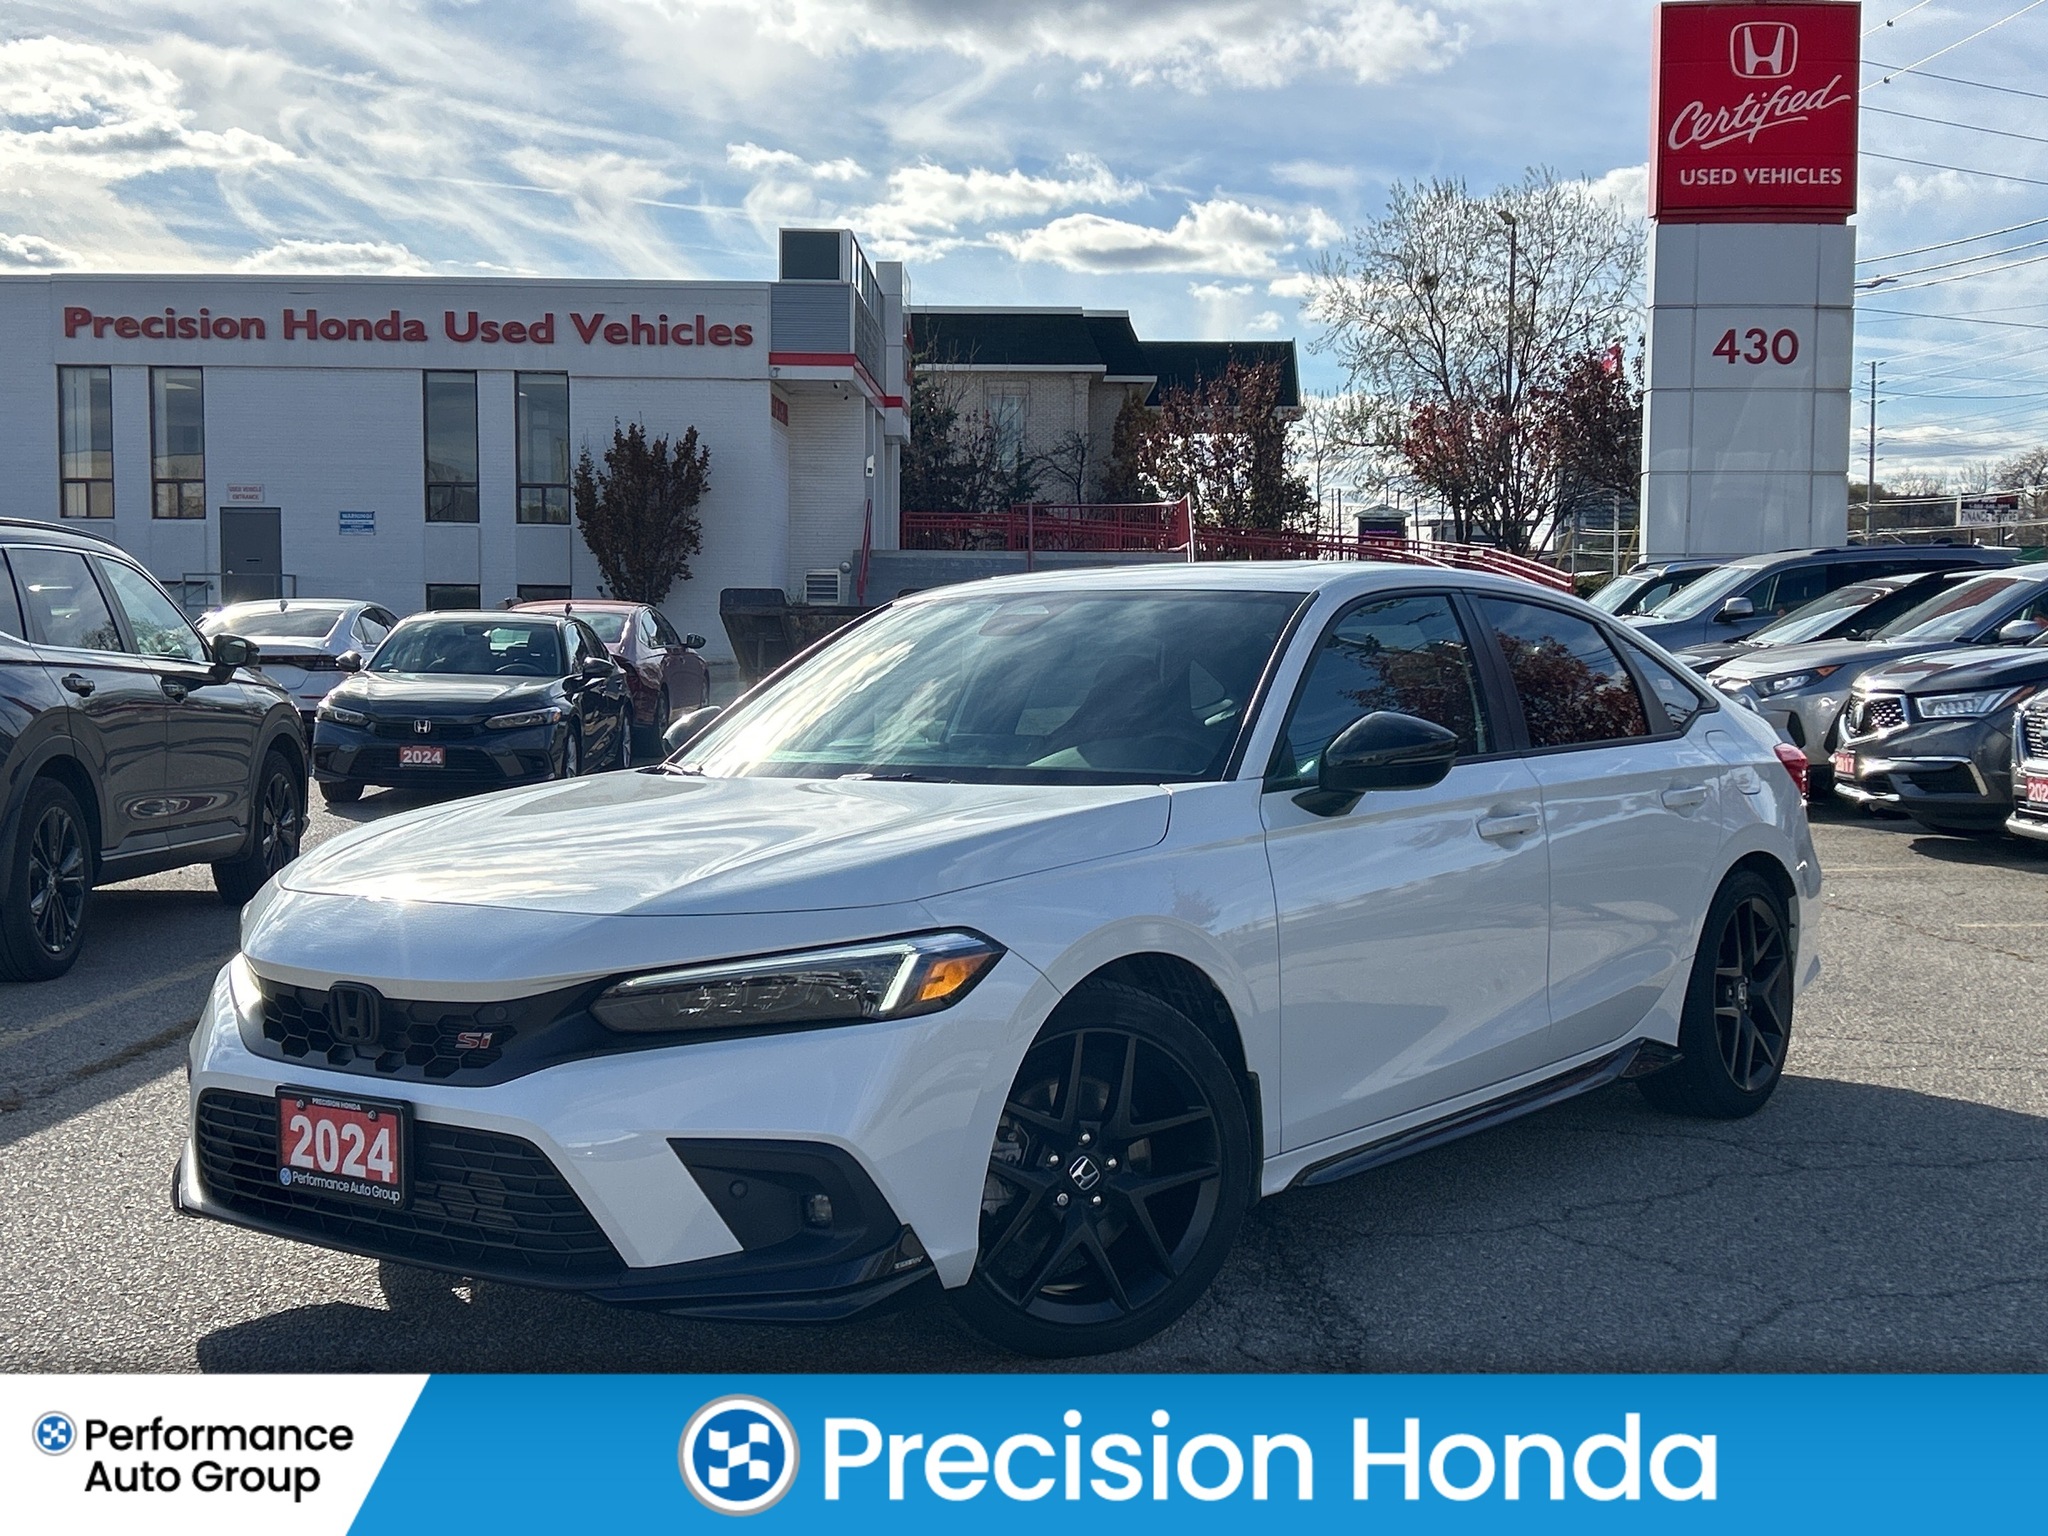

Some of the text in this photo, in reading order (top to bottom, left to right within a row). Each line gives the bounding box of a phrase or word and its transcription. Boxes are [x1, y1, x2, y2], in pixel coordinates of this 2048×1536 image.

[1668, 74, 1852, 150] Certified
[1680, 167, 1842, 186] USED VEHICLES
[64, 307, 754, 348] Precision Honda Used Vehicles
[1712, 328, 1800, 365] 430
[403, 750, 442, 764] 2024
[2028, 782, 2048, 802] 202
[312, 1097, 361, 1111] PRECISION HONDA
[290, 1114, 393, 1182] 2024
[292, 1170, 400, 1205] Performance Auto Group
